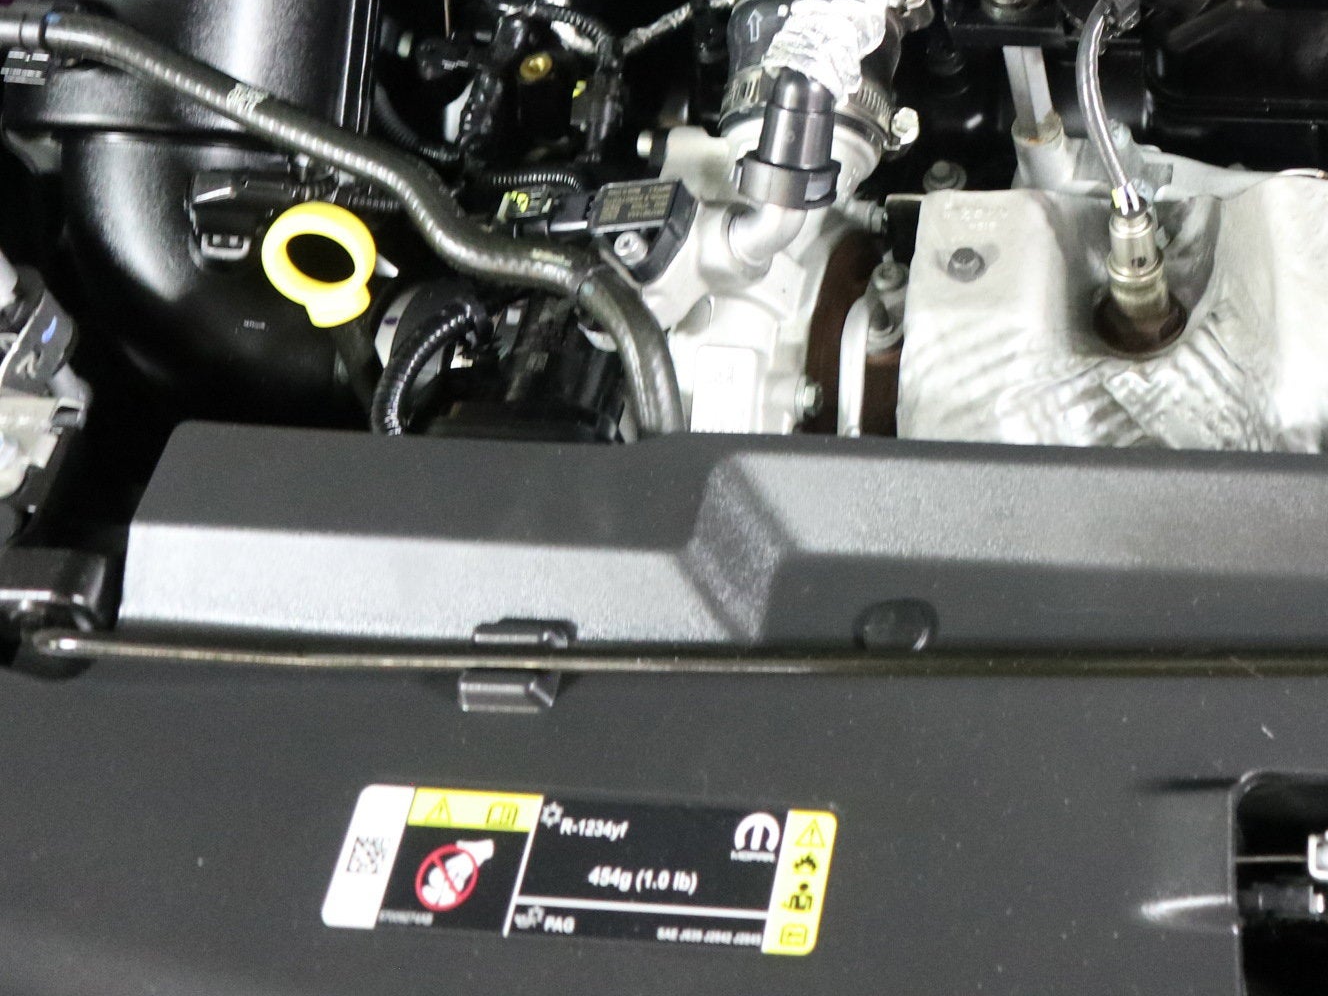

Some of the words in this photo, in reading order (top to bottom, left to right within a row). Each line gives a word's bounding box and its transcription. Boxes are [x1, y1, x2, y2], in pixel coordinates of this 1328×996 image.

[560, 816, 629, 841] R-1234yf
[588, 865, 633, 892] 454g
[635, 868, 670, 893] (1.0
[673, 870, 698, 896] lb)
[543, 915, 576, 934] PAG
